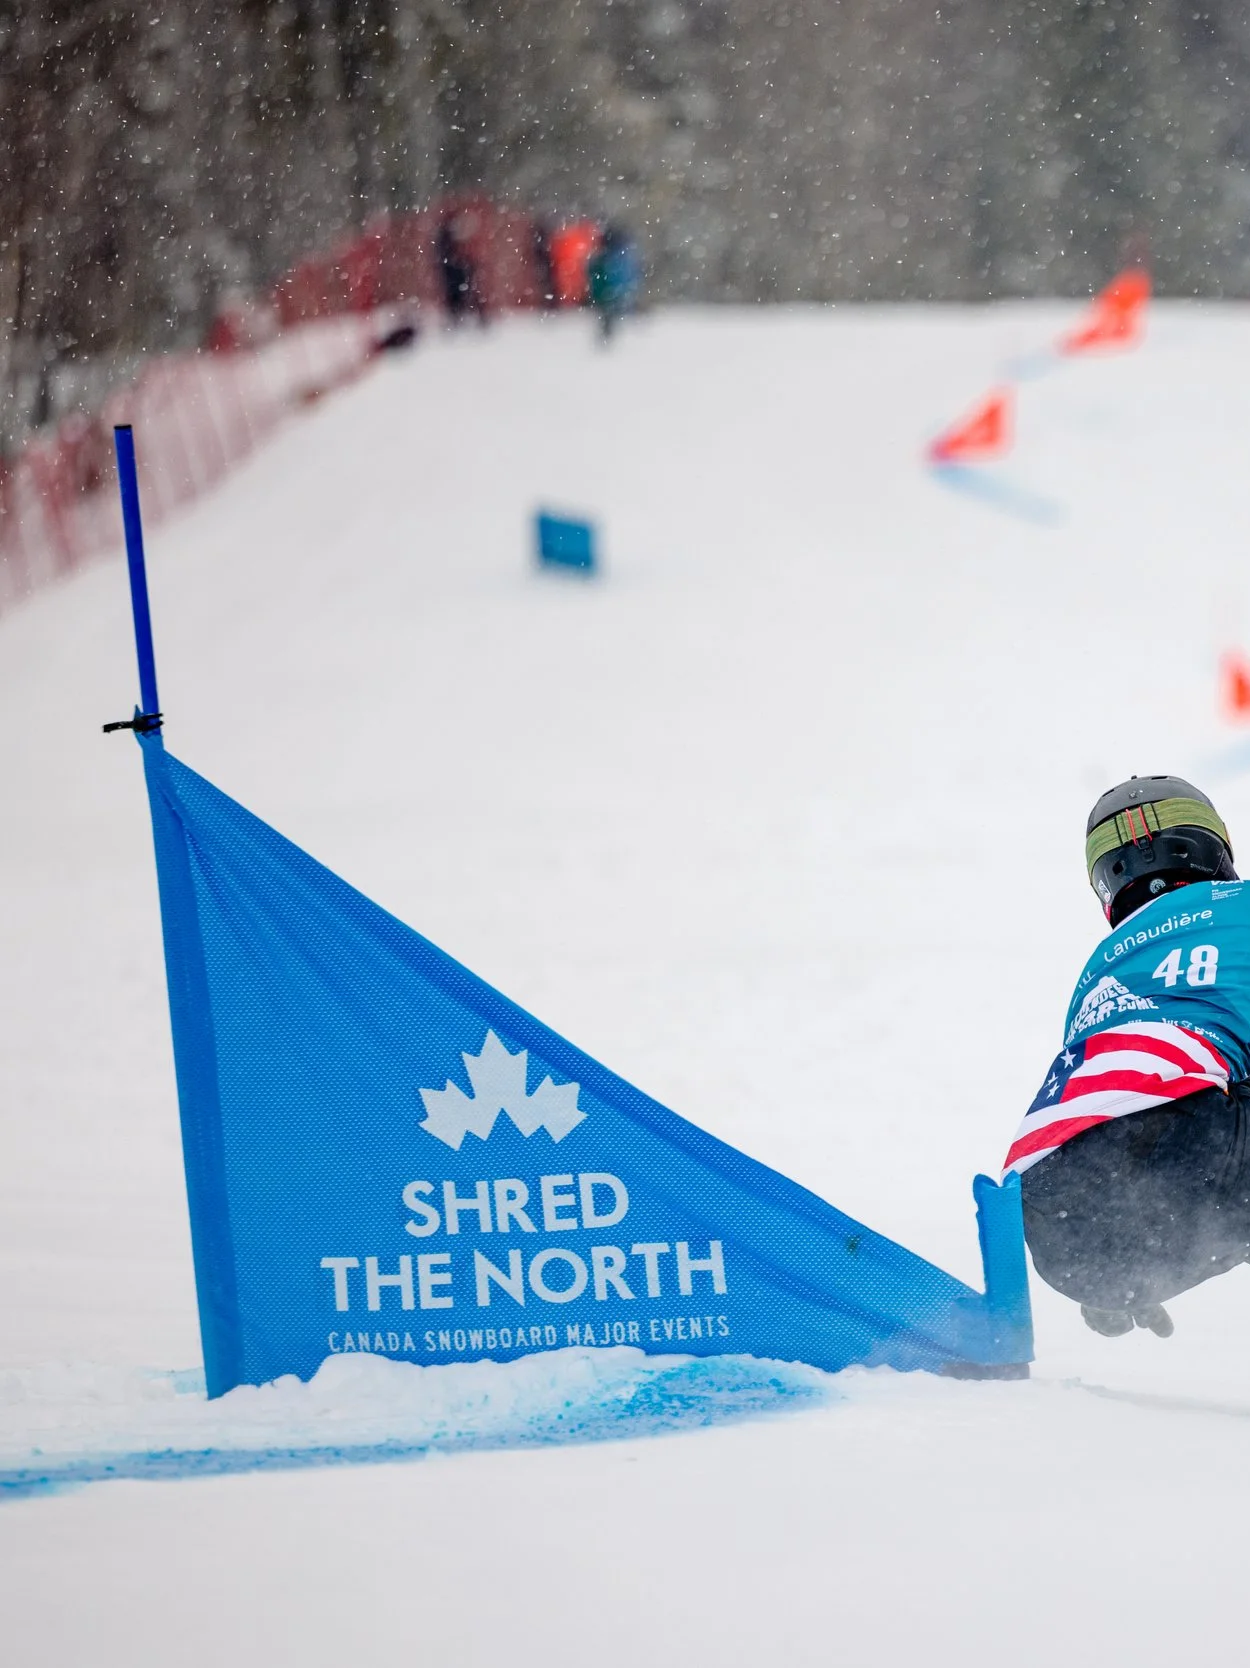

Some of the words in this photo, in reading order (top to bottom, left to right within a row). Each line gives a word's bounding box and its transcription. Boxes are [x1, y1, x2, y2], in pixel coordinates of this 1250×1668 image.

[1105, 909, 1213, 962] Lanaudière
[1152, 945, 1219, 988] 48
[402, 1172, 630, 1238] SHRED
[320, 1254, 454, 1312] THE
[474, 1240, 728, 1308] NORTH
[327, 1331, 417, 1353] CANADA
[426, 1324, 558, 1350] SNOWBOARD
[567, 1320, 641, 1346] MAJOR
[650, 1316, 731, 1343] EVENTS
